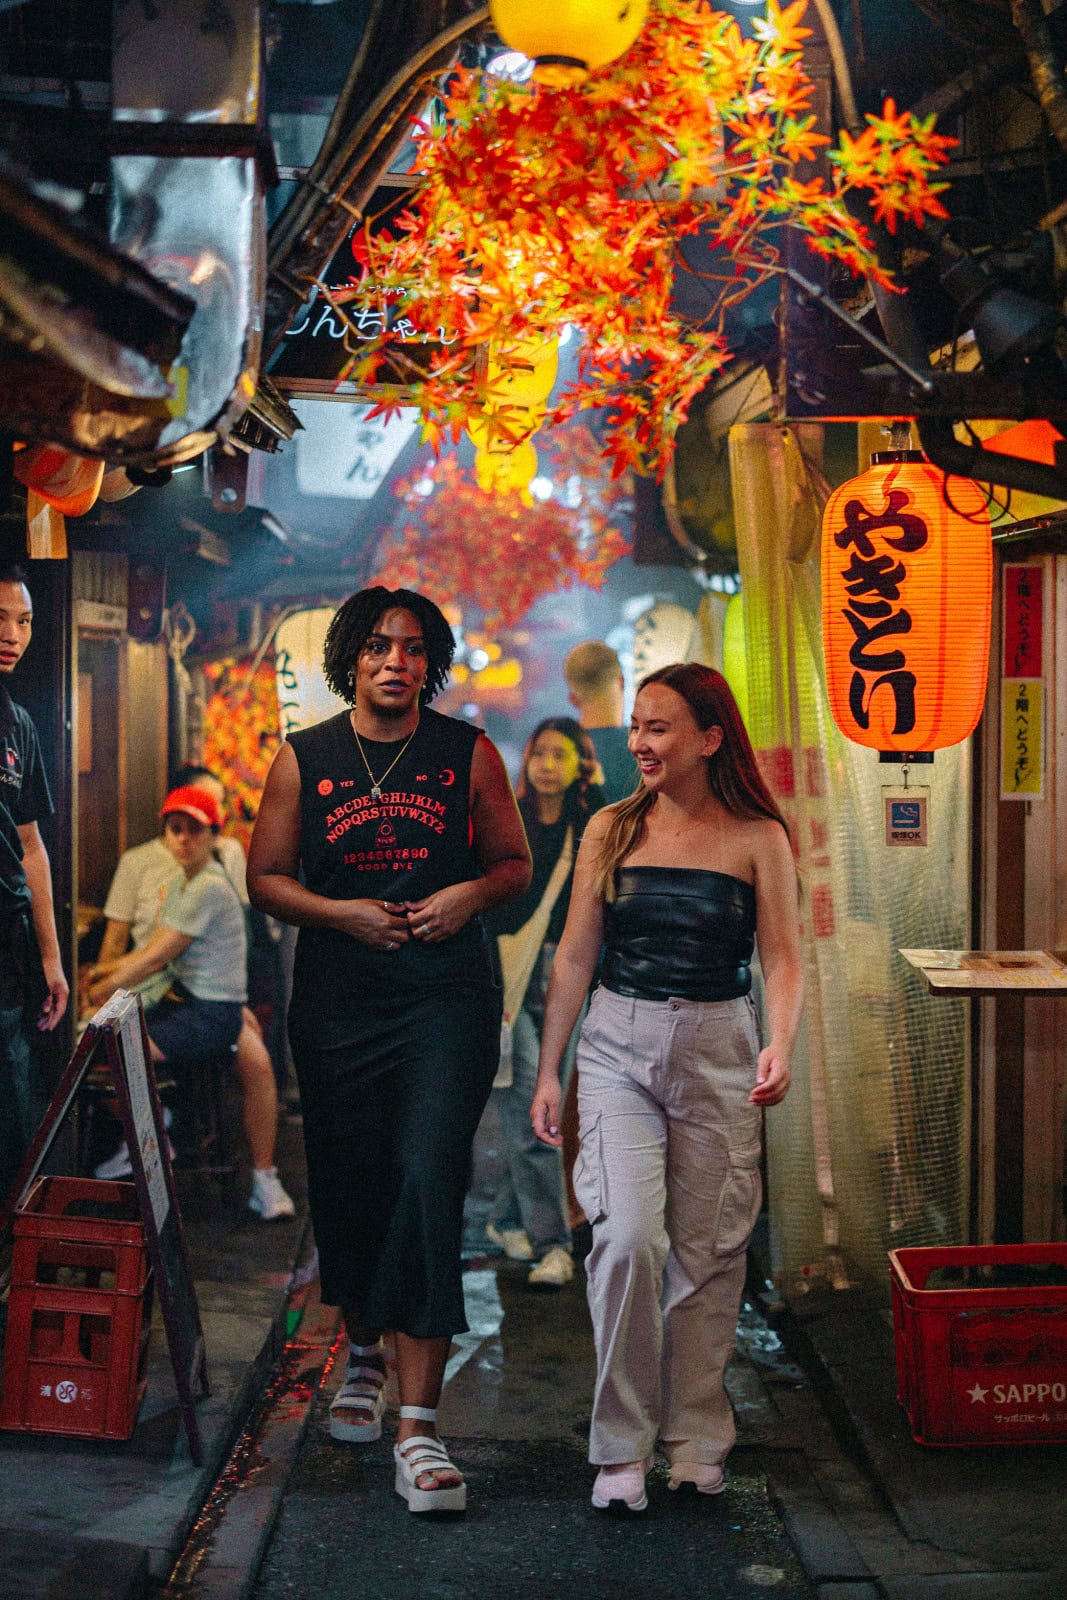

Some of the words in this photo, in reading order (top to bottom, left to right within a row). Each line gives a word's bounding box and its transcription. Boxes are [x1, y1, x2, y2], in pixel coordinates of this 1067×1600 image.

[833, 489, 929, 735] やきとり
[340, 780, 355, 788] YES
[416, 774, 428, 782] NO
[325, 805, 447, 845] NOPQRSTUVWXYZ
[343, 847, 429, 864] 1234567890
[357, 863, 388, 871] GOOD
[392, 862, 414, 871] BYE
[993, 1382, 1067, 1404] SAPPO
